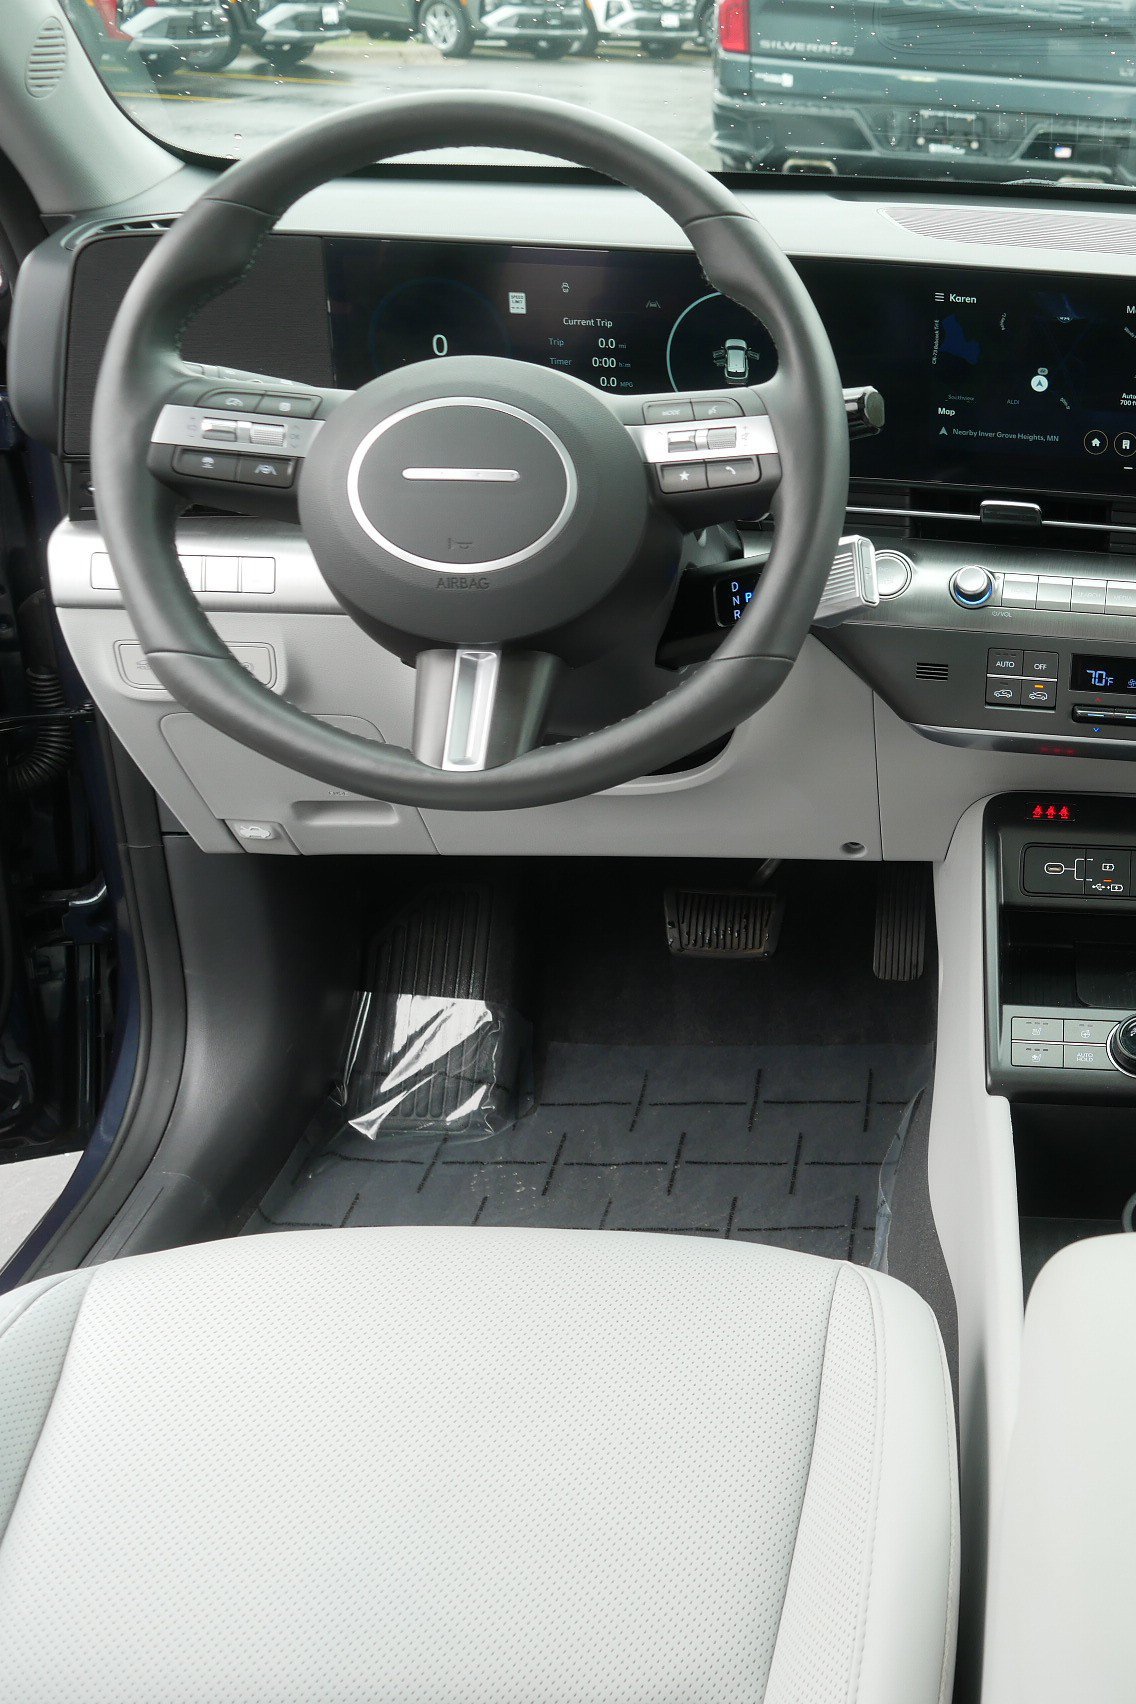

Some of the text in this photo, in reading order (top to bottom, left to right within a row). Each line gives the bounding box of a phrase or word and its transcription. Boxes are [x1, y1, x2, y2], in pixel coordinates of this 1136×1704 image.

[949, 293, 977, 304] Karen
[562, 317, 613, 329] Current Trip
[432, 333, 448, 356] 0
[548, 337, 565, 347] Trip
[598, 337, 616, 349] 0.0
[549, 357, 572, 366] Timer
[591, 356, 617, 368] 0:00
[600, 376, 617, 387] 0.0
[1121, 392, 1136, 400] Auto
[1120, 399, 1132, 407] 700
[937, 407, 956, 416] Map
[952, 428, 1060, 442] Nearby Inver Grove Heights, MN
[435, 577, 490, 591] AIRBAG
[731, 581, 739, 592] D
[732, 595, 740, 606] N
[745, 592, 752, 603] P
[733, 609, 741, 620] R
[995, 660, 1016, 668] AUTO
[1033, 662, 1048, 671] OFF
